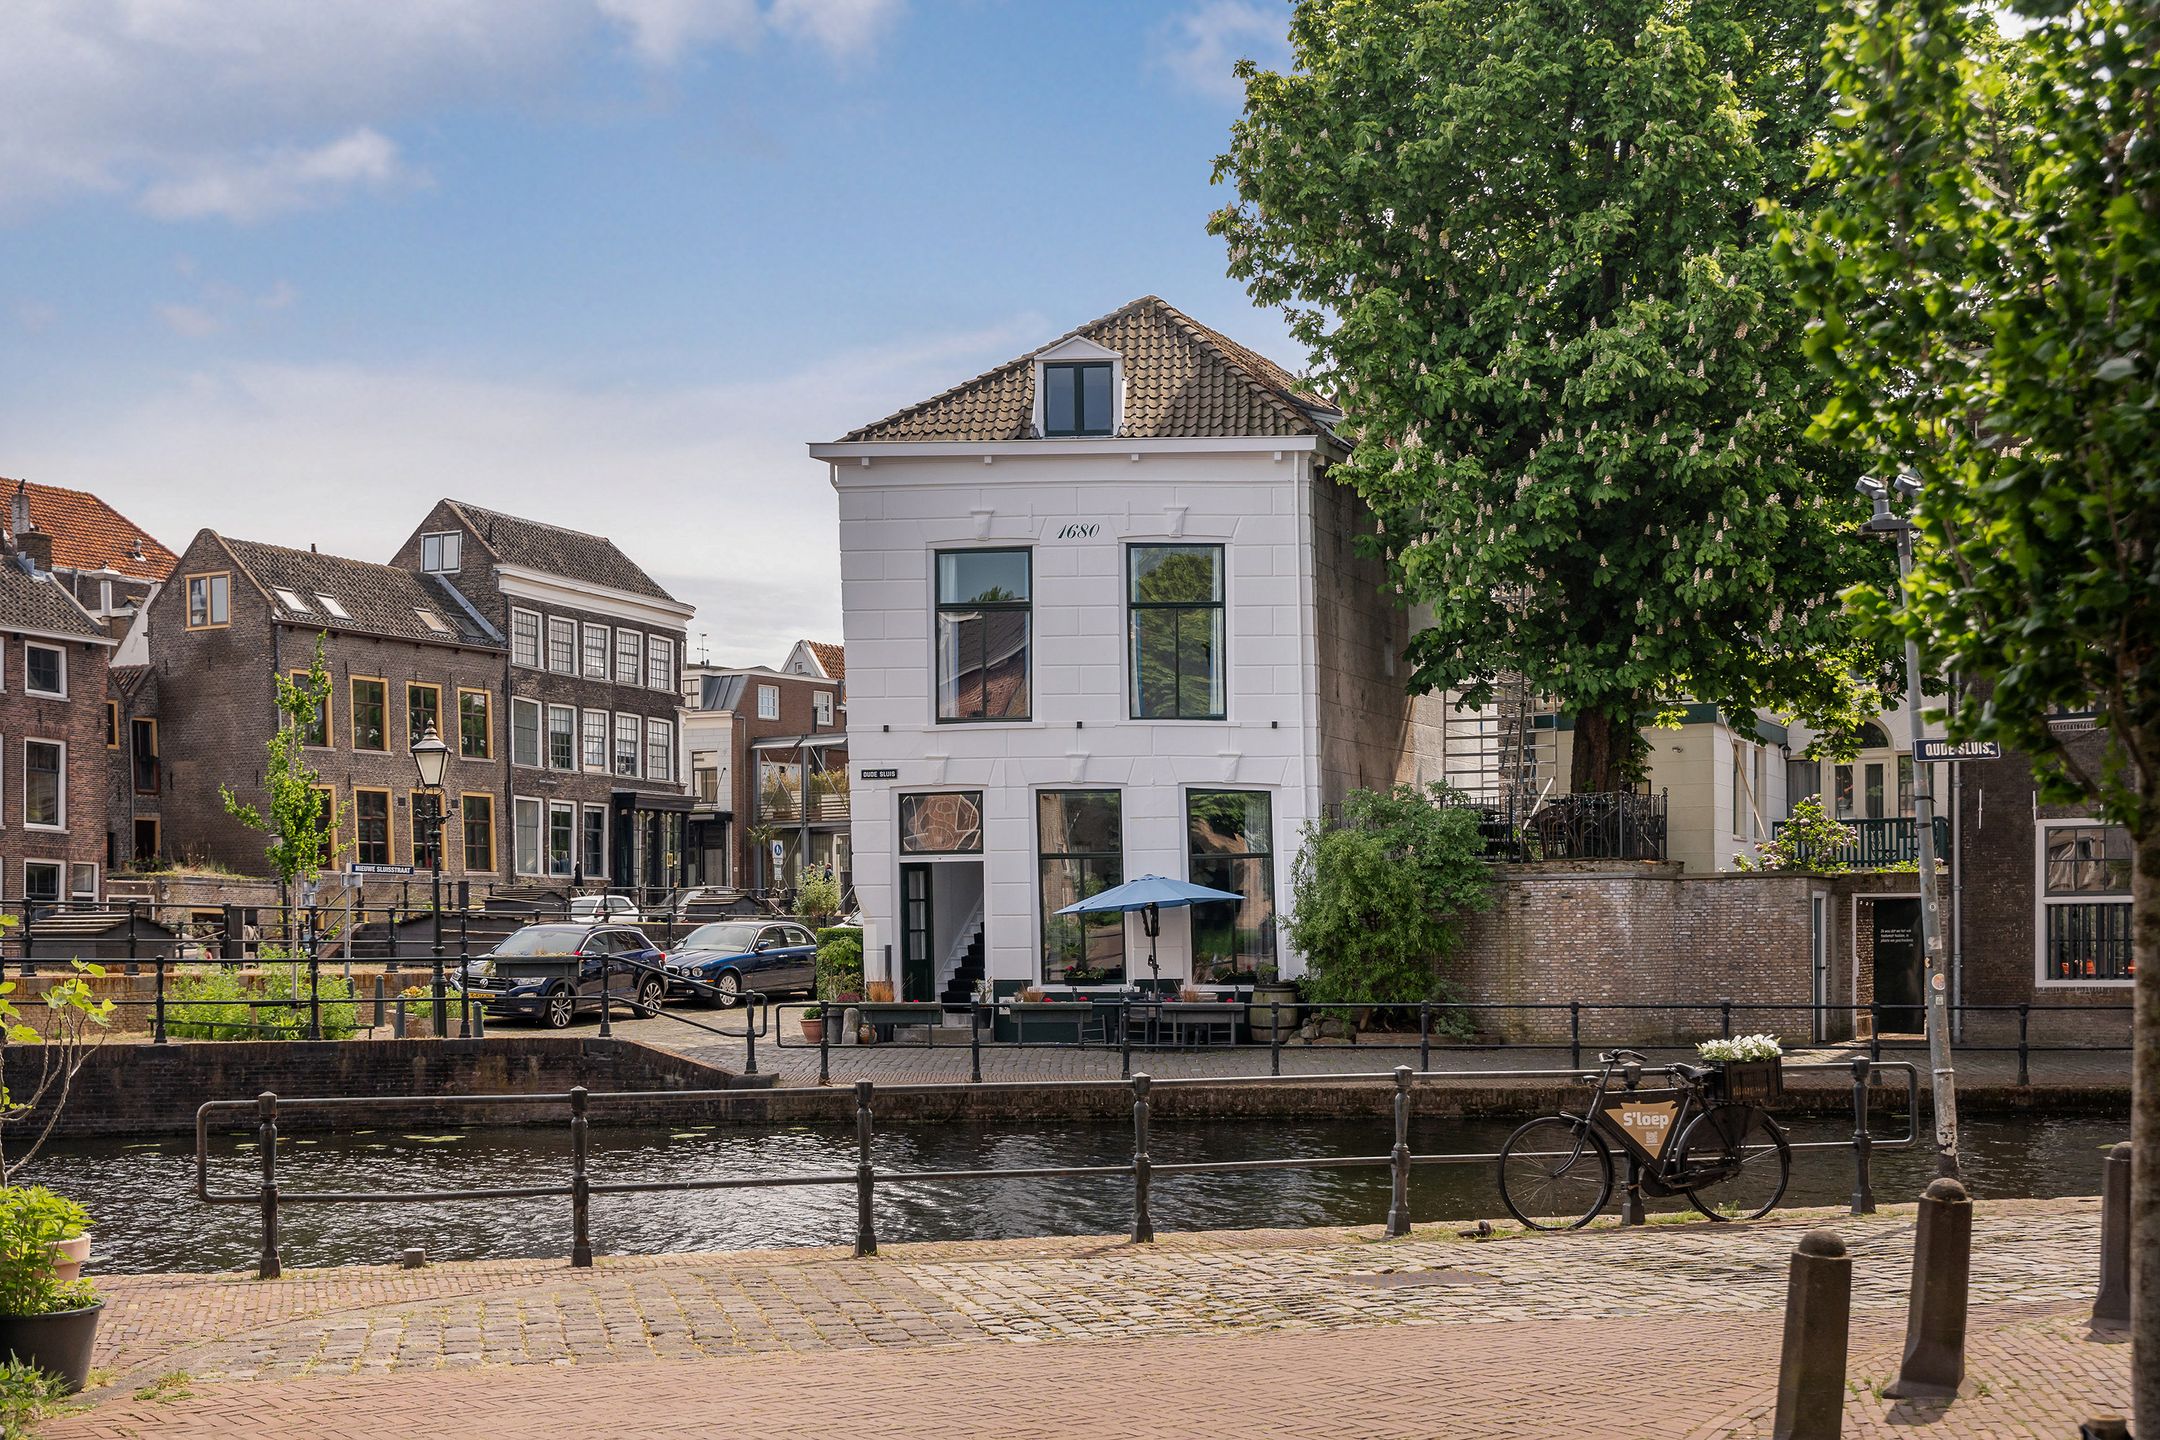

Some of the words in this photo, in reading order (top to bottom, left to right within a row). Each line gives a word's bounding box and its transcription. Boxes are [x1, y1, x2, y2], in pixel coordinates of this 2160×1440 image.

[1056, 523, 1100, 539] 1680
[1925, 743, 1955, 757] OUDE
[1958, 742, 1990, 755] SLUIS
[355, 865, 376, 873] NIEUWE
[377, 866, 411, 874] SLUISSTRAAT
[1623, 1112, 1669, 1129] S'loep
